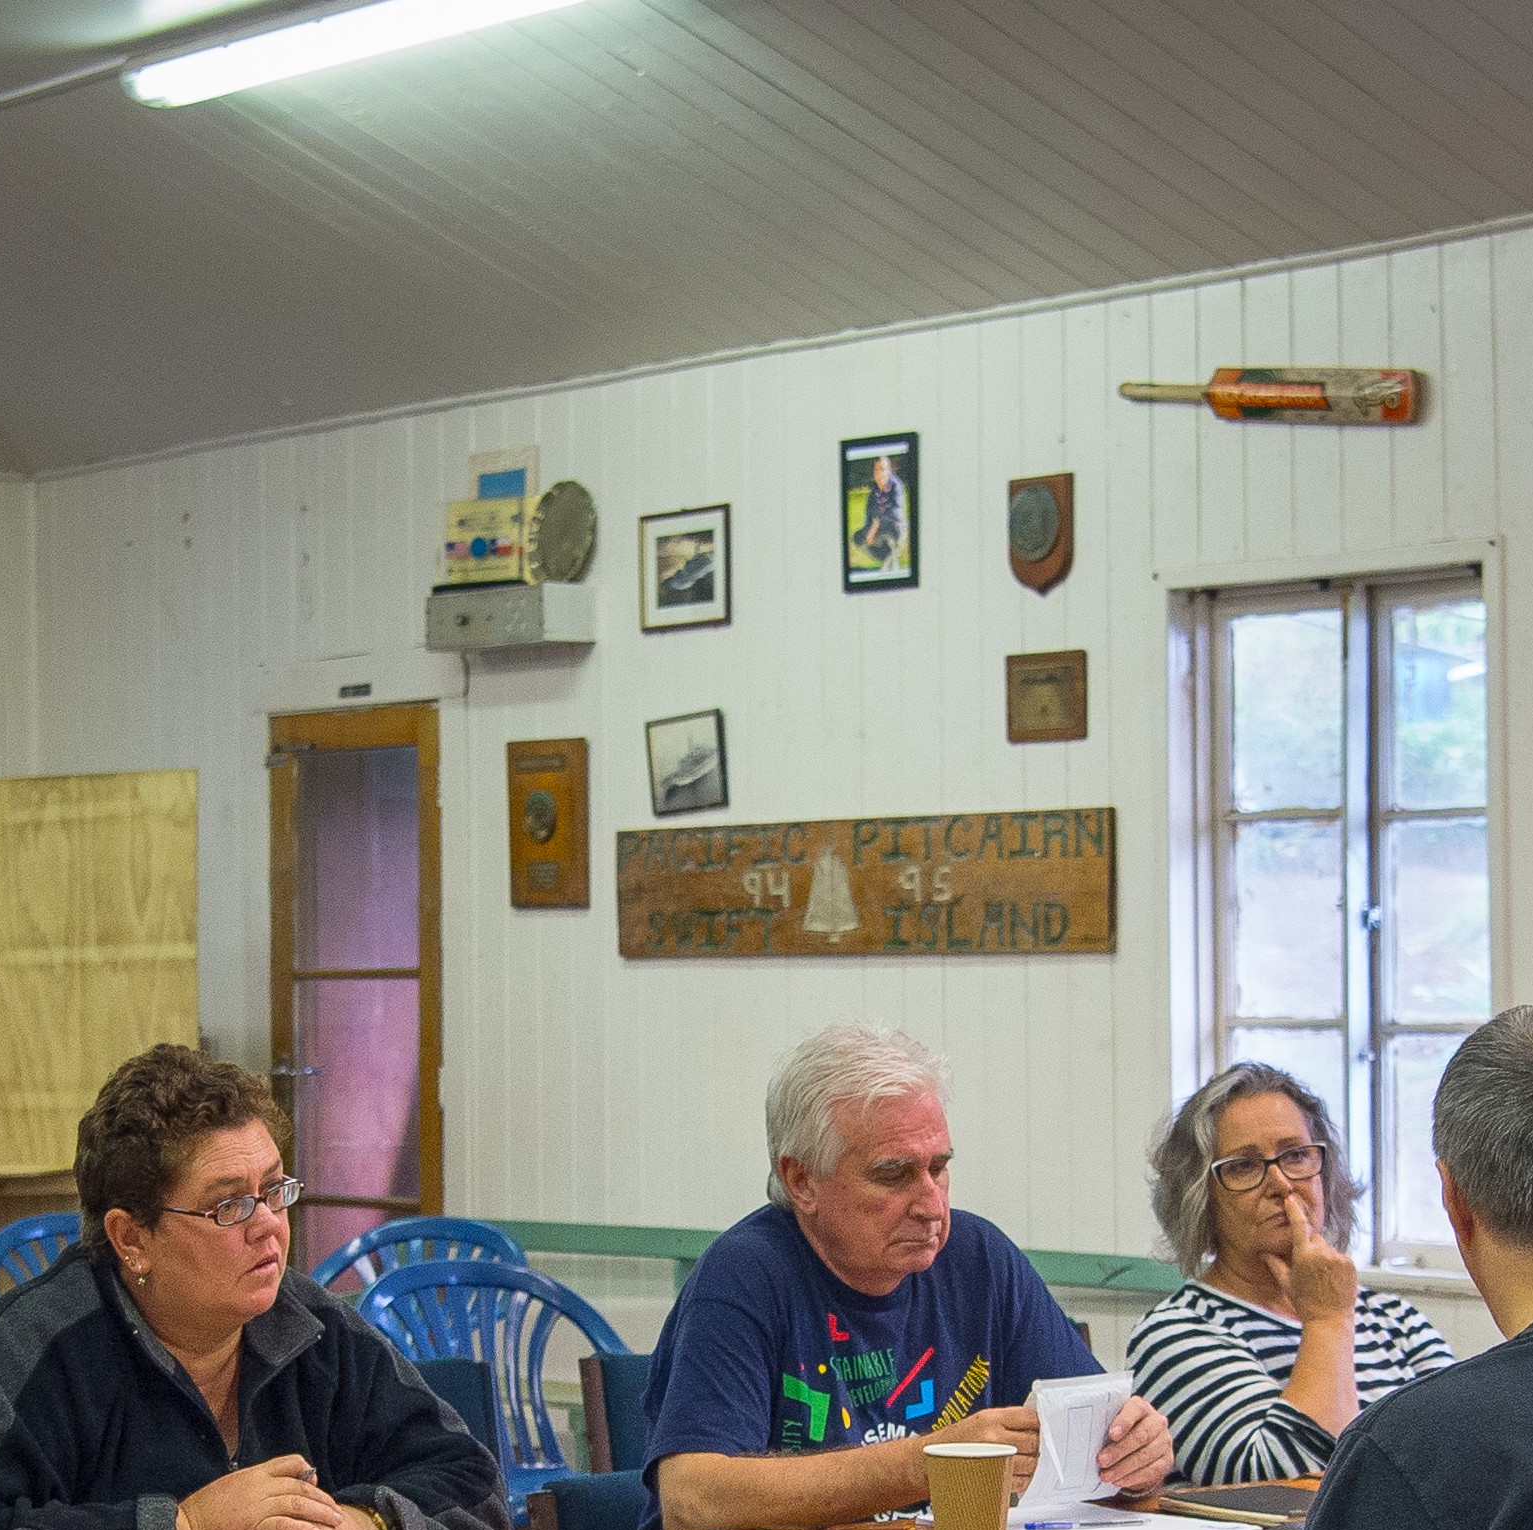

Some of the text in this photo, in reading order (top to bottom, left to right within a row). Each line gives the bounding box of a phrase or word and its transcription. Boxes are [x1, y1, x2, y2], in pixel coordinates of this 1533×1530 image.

[618, 809, 1105, 874] PACIFIC PITCAIRN
[741, 863, 953, 908] 94 95
[646, 899, 1071, 956] SWIFT ISLAND
